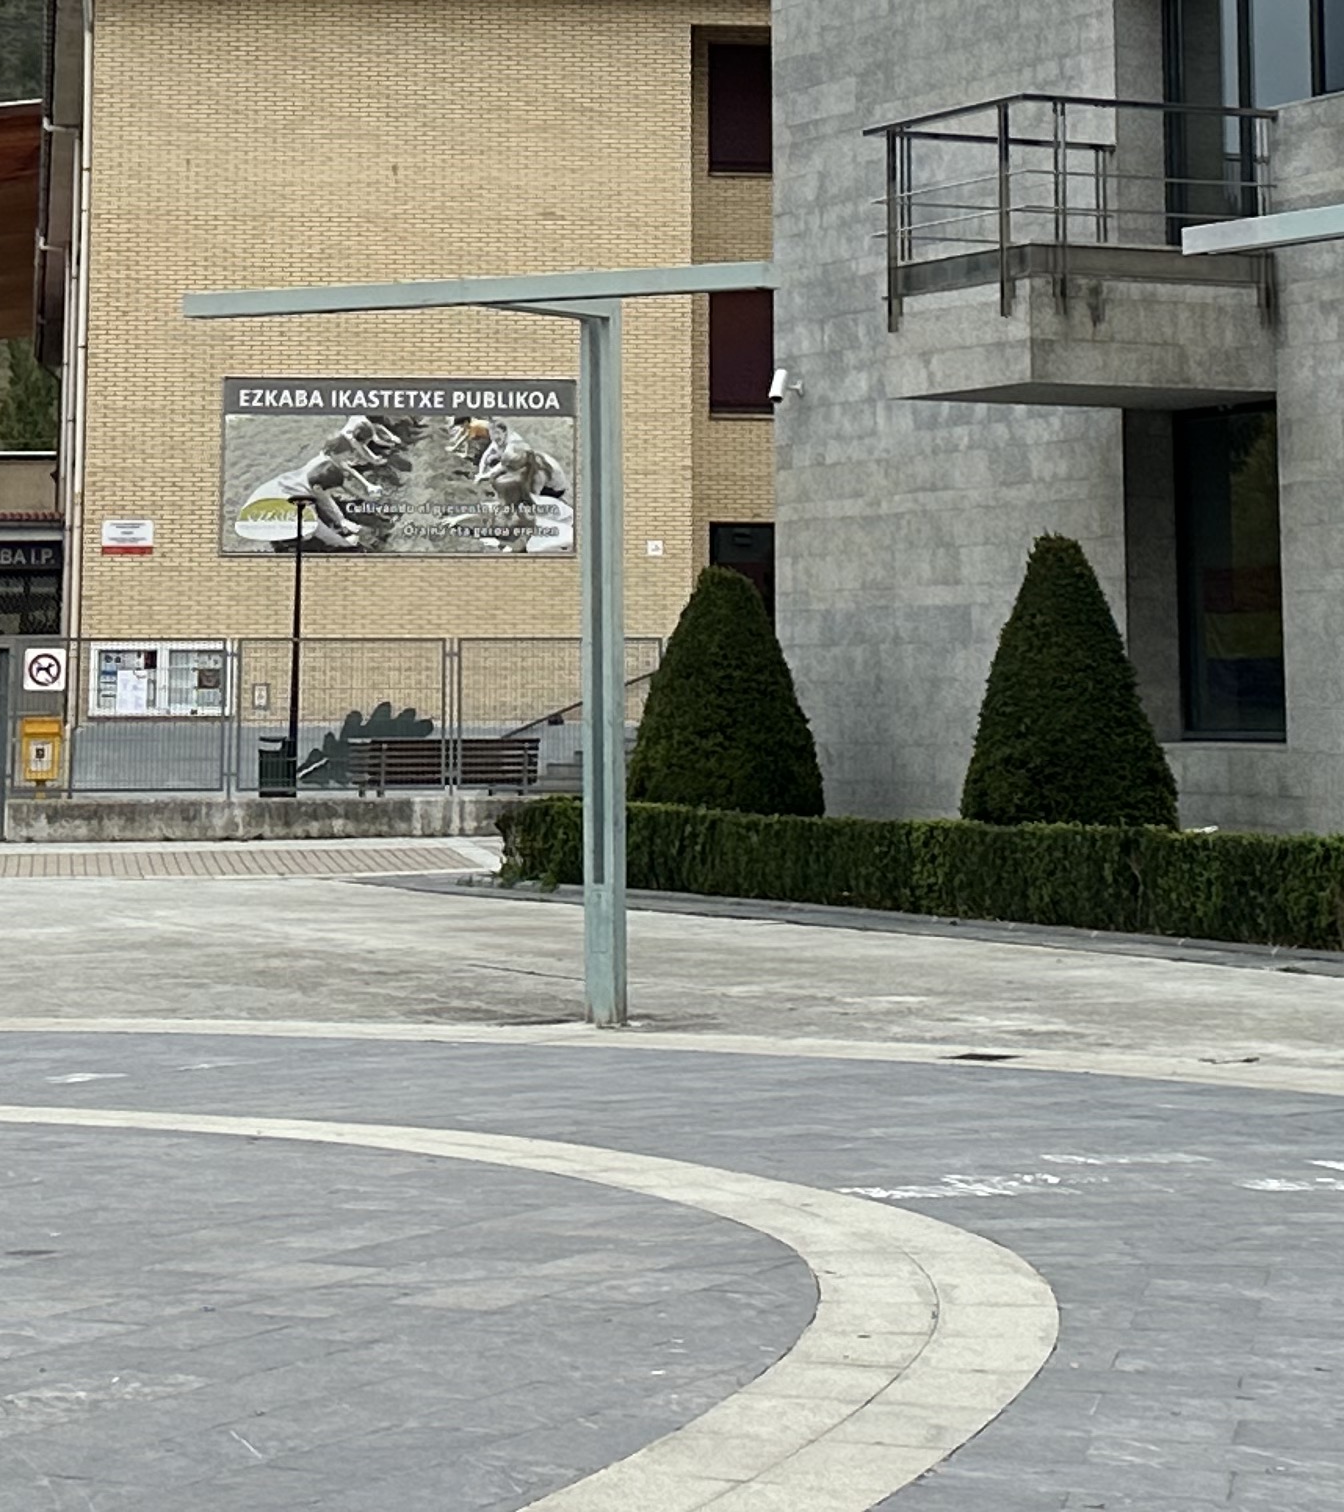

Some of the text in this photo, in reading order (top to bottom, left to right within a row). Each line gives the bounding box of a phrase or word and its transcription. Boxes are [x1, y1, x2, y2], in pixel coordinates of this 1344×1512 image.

[238, 389, 561, 409] EZKABA IKASTETXE PUBLIKOA
[30, 548, 56, 565] I.P.
